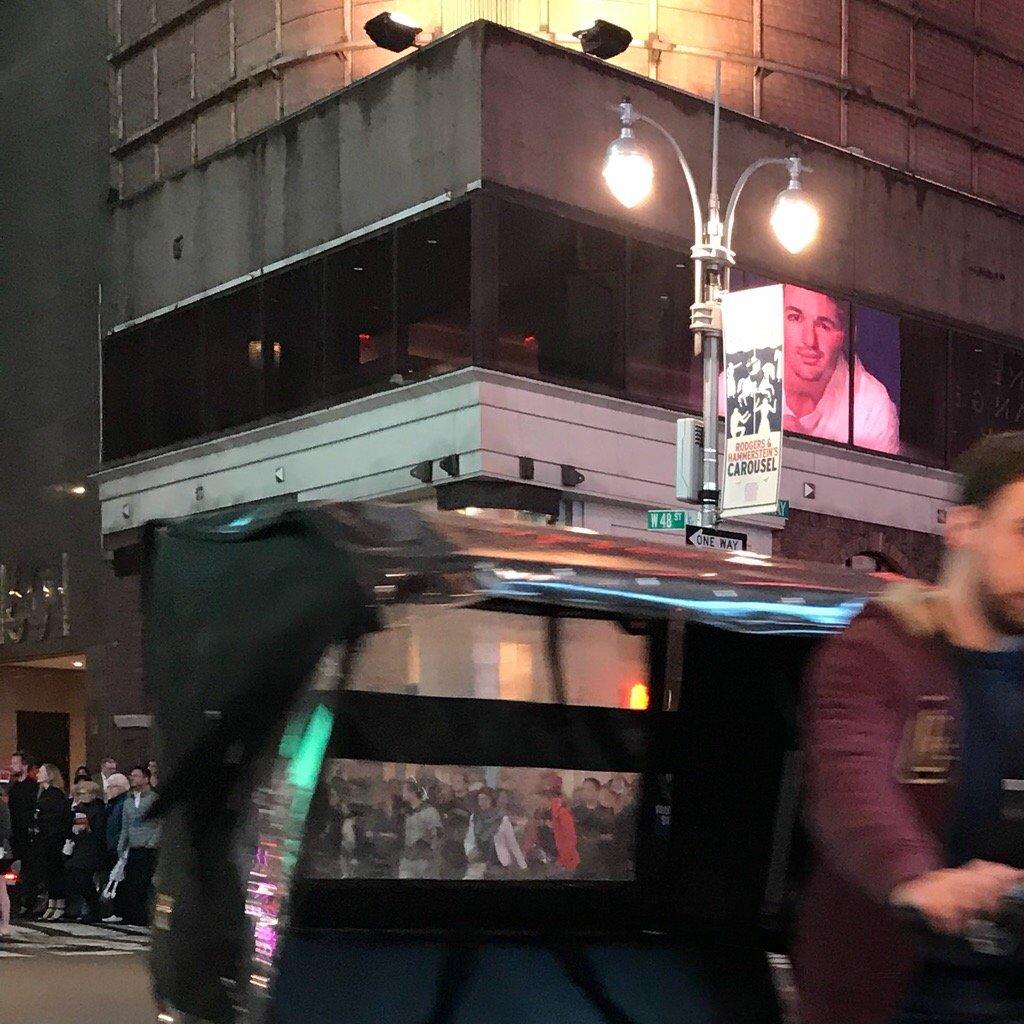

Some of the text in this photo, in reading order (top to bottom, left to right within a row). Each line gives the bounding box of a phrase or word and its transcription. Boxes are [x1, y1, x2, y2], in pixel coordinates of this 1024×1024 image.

[736, 438, 772, 452] RODGERS &
[728, 447, 778, 461] HAMMERSTEIN'S
[727, 457, 777, 477] CAROUSEL
[651, 512, 682, 528] W 48 ST
[696, 535, 738, 550] ONE WAY
